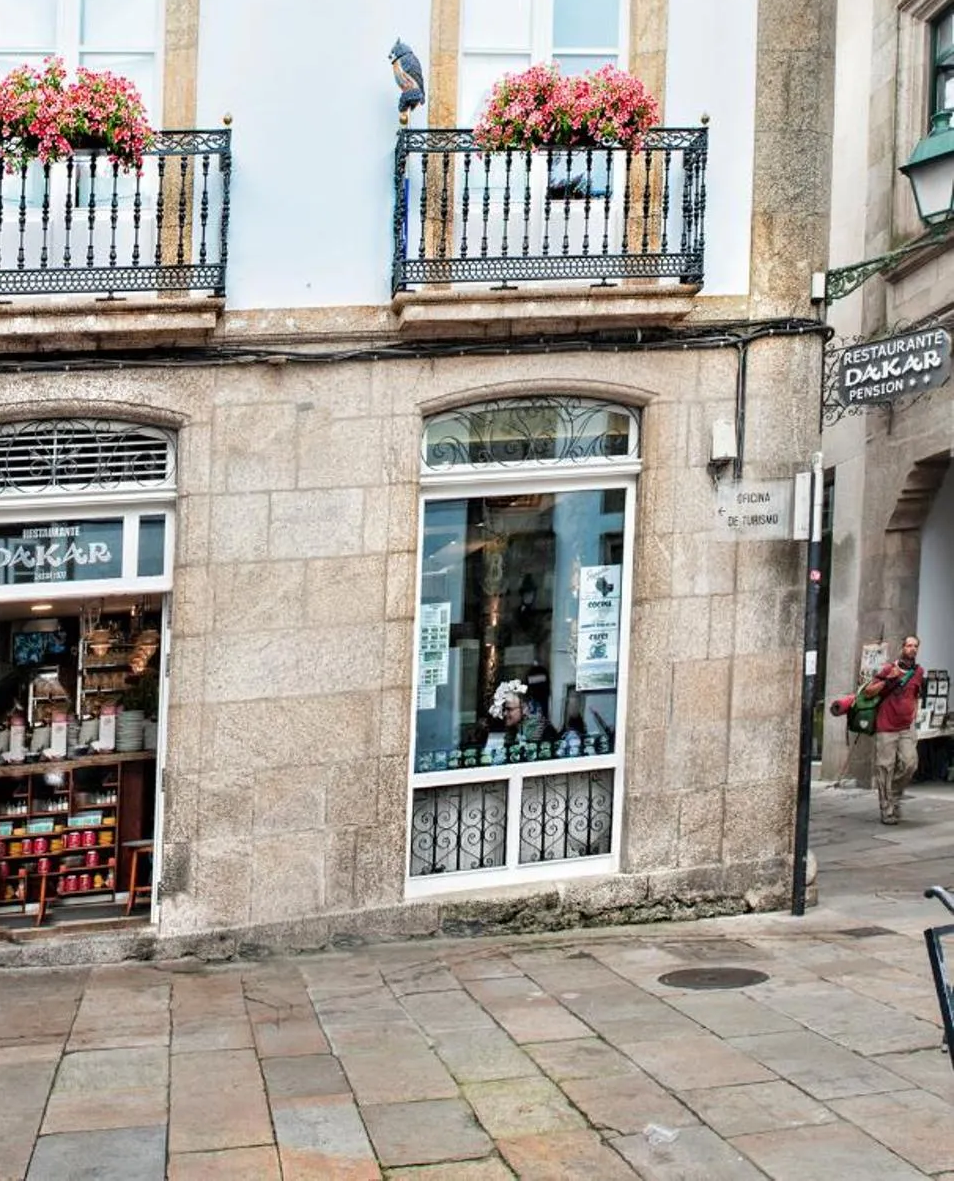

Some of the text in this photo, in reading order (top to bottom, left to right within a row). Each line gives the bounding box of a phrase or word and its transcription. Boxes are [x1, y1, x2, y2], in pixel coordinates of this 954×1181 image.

[843, 330, 944, 366] RESTAURANTE
[845, 350, 942, 387] DAKAR
[849, 380, 904, 401] PENSION
[736, 492, 771, 505] OFICINA
[727, 514, 779, 527] DE TURISMO
